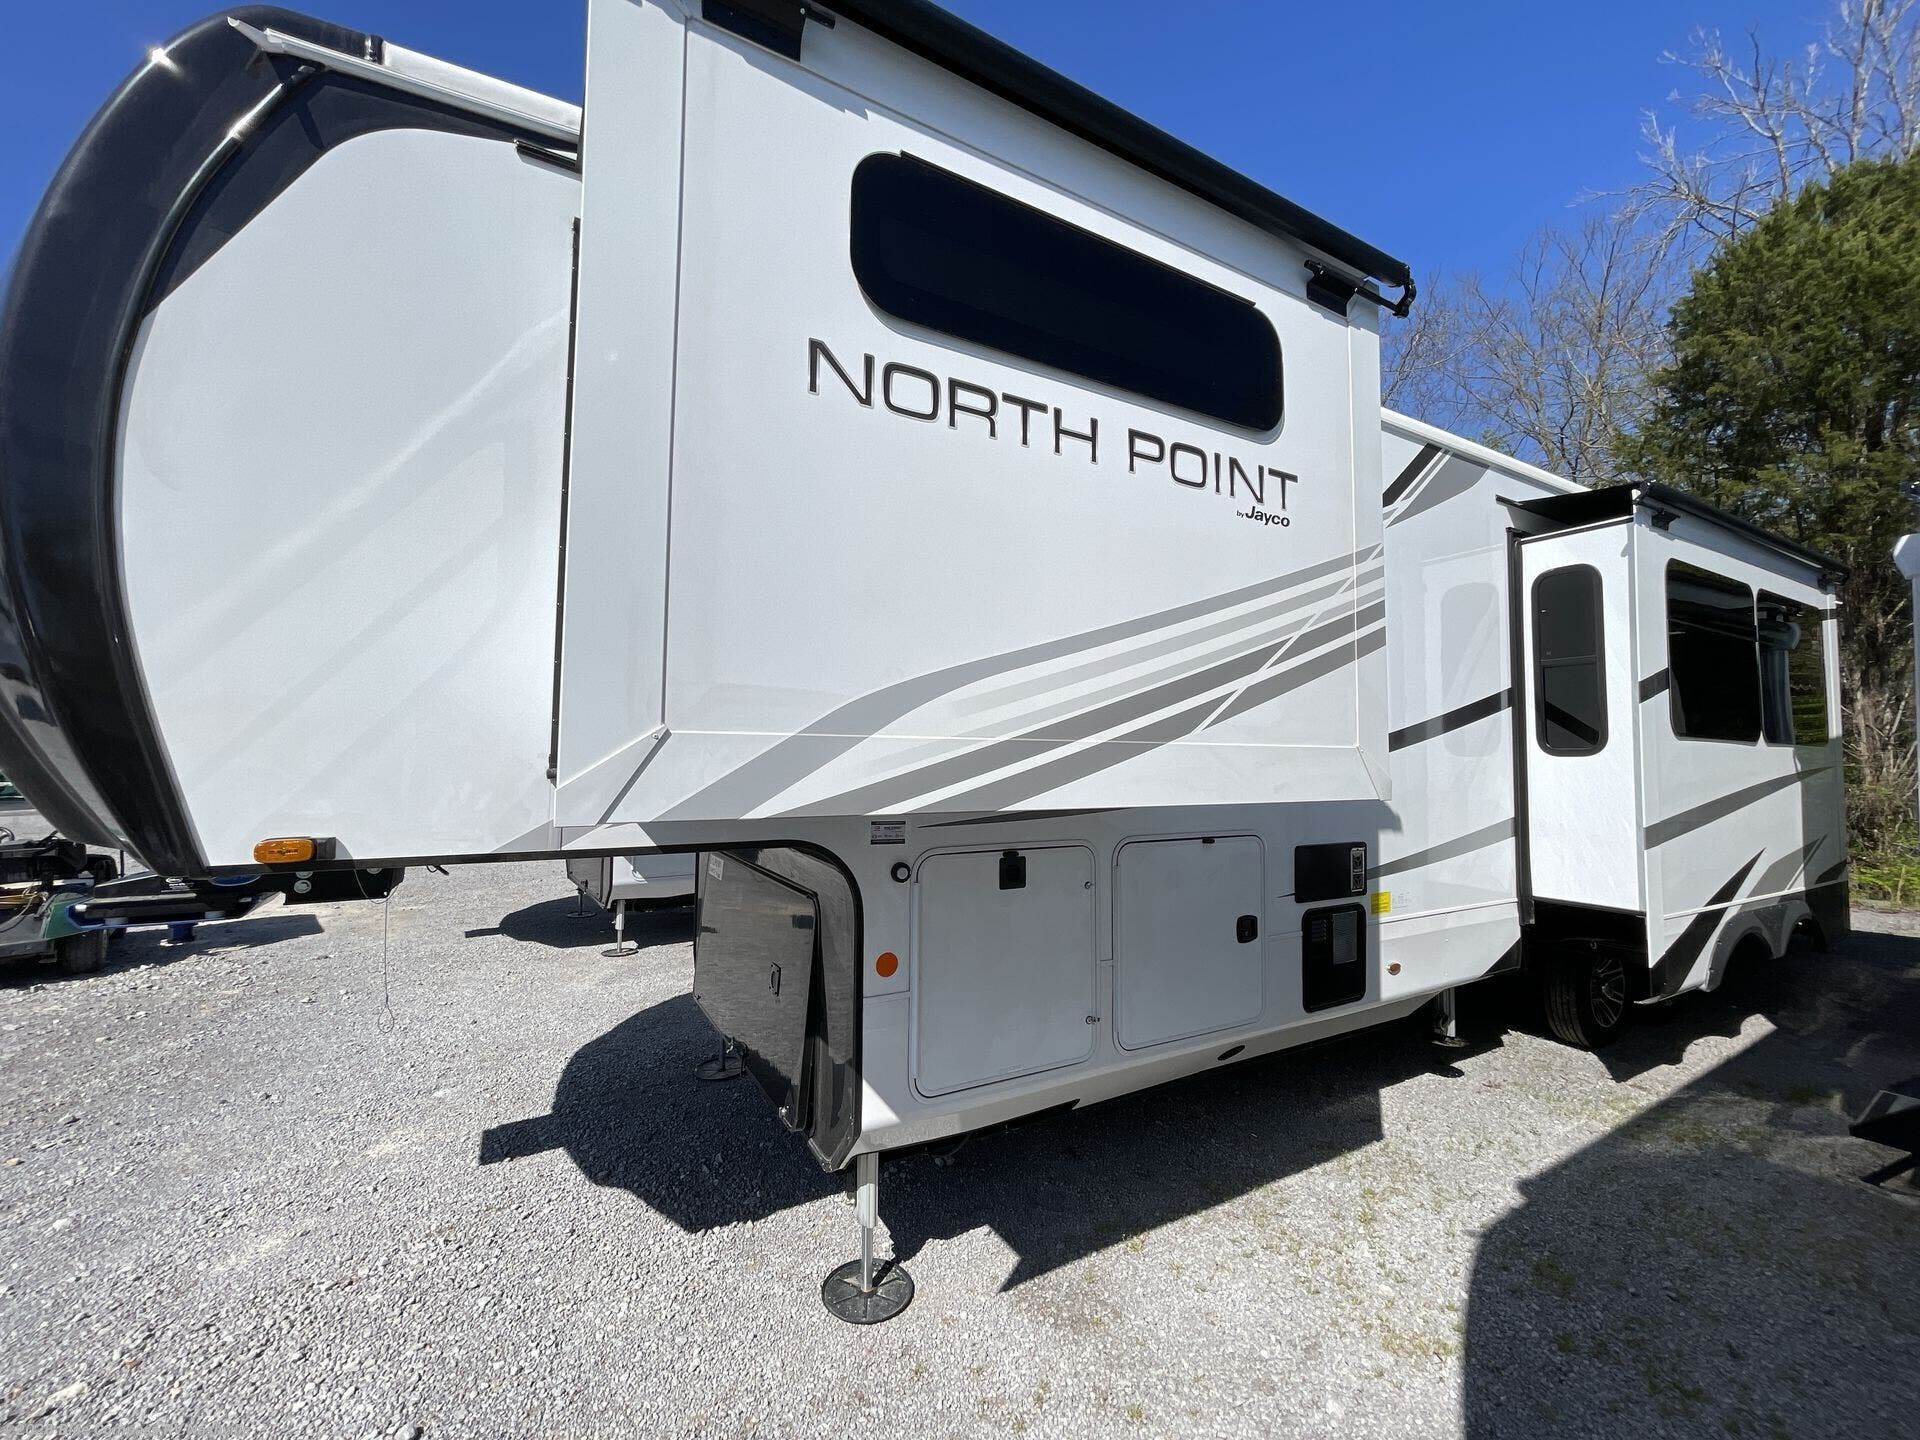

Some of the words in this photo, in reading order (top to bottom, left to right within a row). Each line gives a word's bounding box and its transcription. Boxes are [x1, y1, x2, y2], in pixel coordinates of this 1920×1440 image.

[808, 336, 1099, 465] NORTH
[1127, 427, 1299, 511] POINT
[1236, 509, 1245, 518] by
[1245, 505, 1291, 528] Jayco
